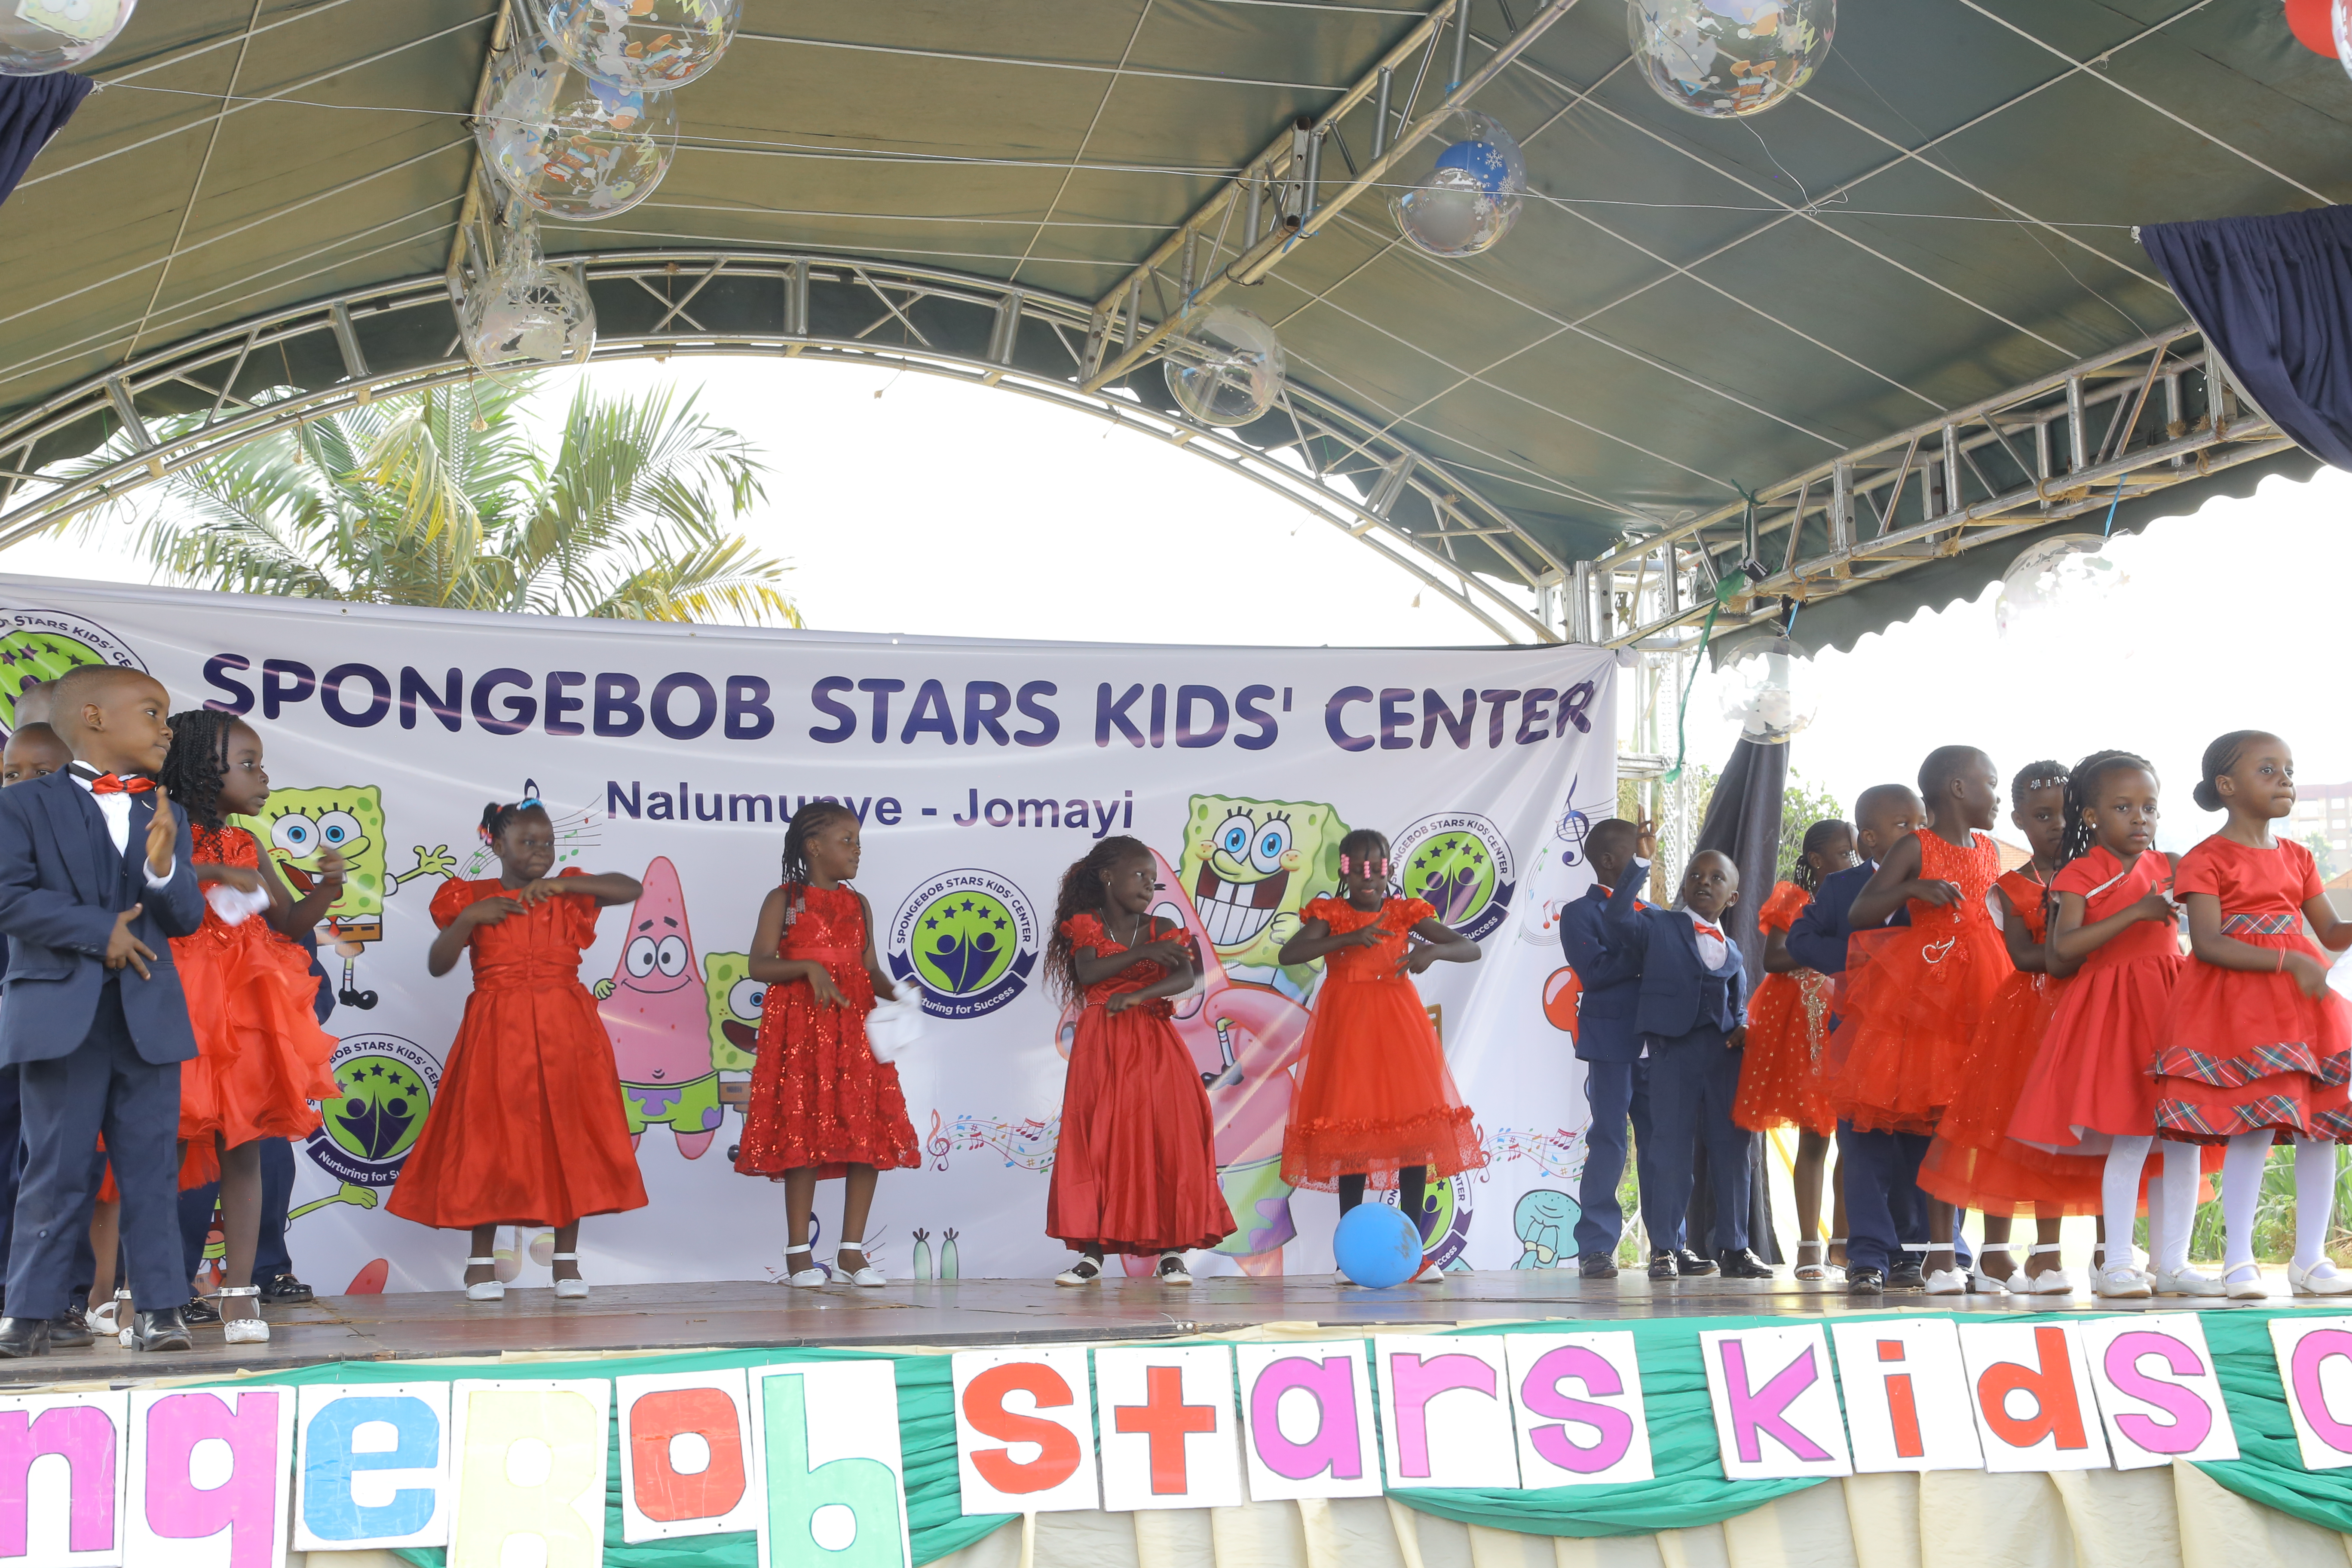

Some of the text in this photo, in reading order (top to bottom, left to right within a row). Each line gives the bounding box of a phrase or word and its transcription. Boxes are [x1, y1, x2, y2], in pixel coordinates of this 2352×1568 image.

[14, 616, 67, 631] STARS
[72, 626, 114, 649] KIDS'
[202, 653, 1594, 752] SPONGEBOB STARS KIDS' CENTER
[606, 781, 902, 830] Nalumuye
[953, 788, 1133, 838] Jomayi
[1390, 819, 1507, 884] SONGEBOB STARS KIDS' CENTER
[897, 876, 1031, 944] SPONGEBOB STARS KIDS' CENTER
[1462, 916, 1498, 939] Success
[922, 986, 1015, 1015] turing for Success
[354, 1041, 394, 1052] STARS
[396, 1047, 426, 1065] KIDS'
[424, 1066, 440, 1089] CEN
[318, 1151, 369, 1182] Nurturing
[371, 1172, 387, 1182] for
[1454, 1173, 1465, 1202] NTER
